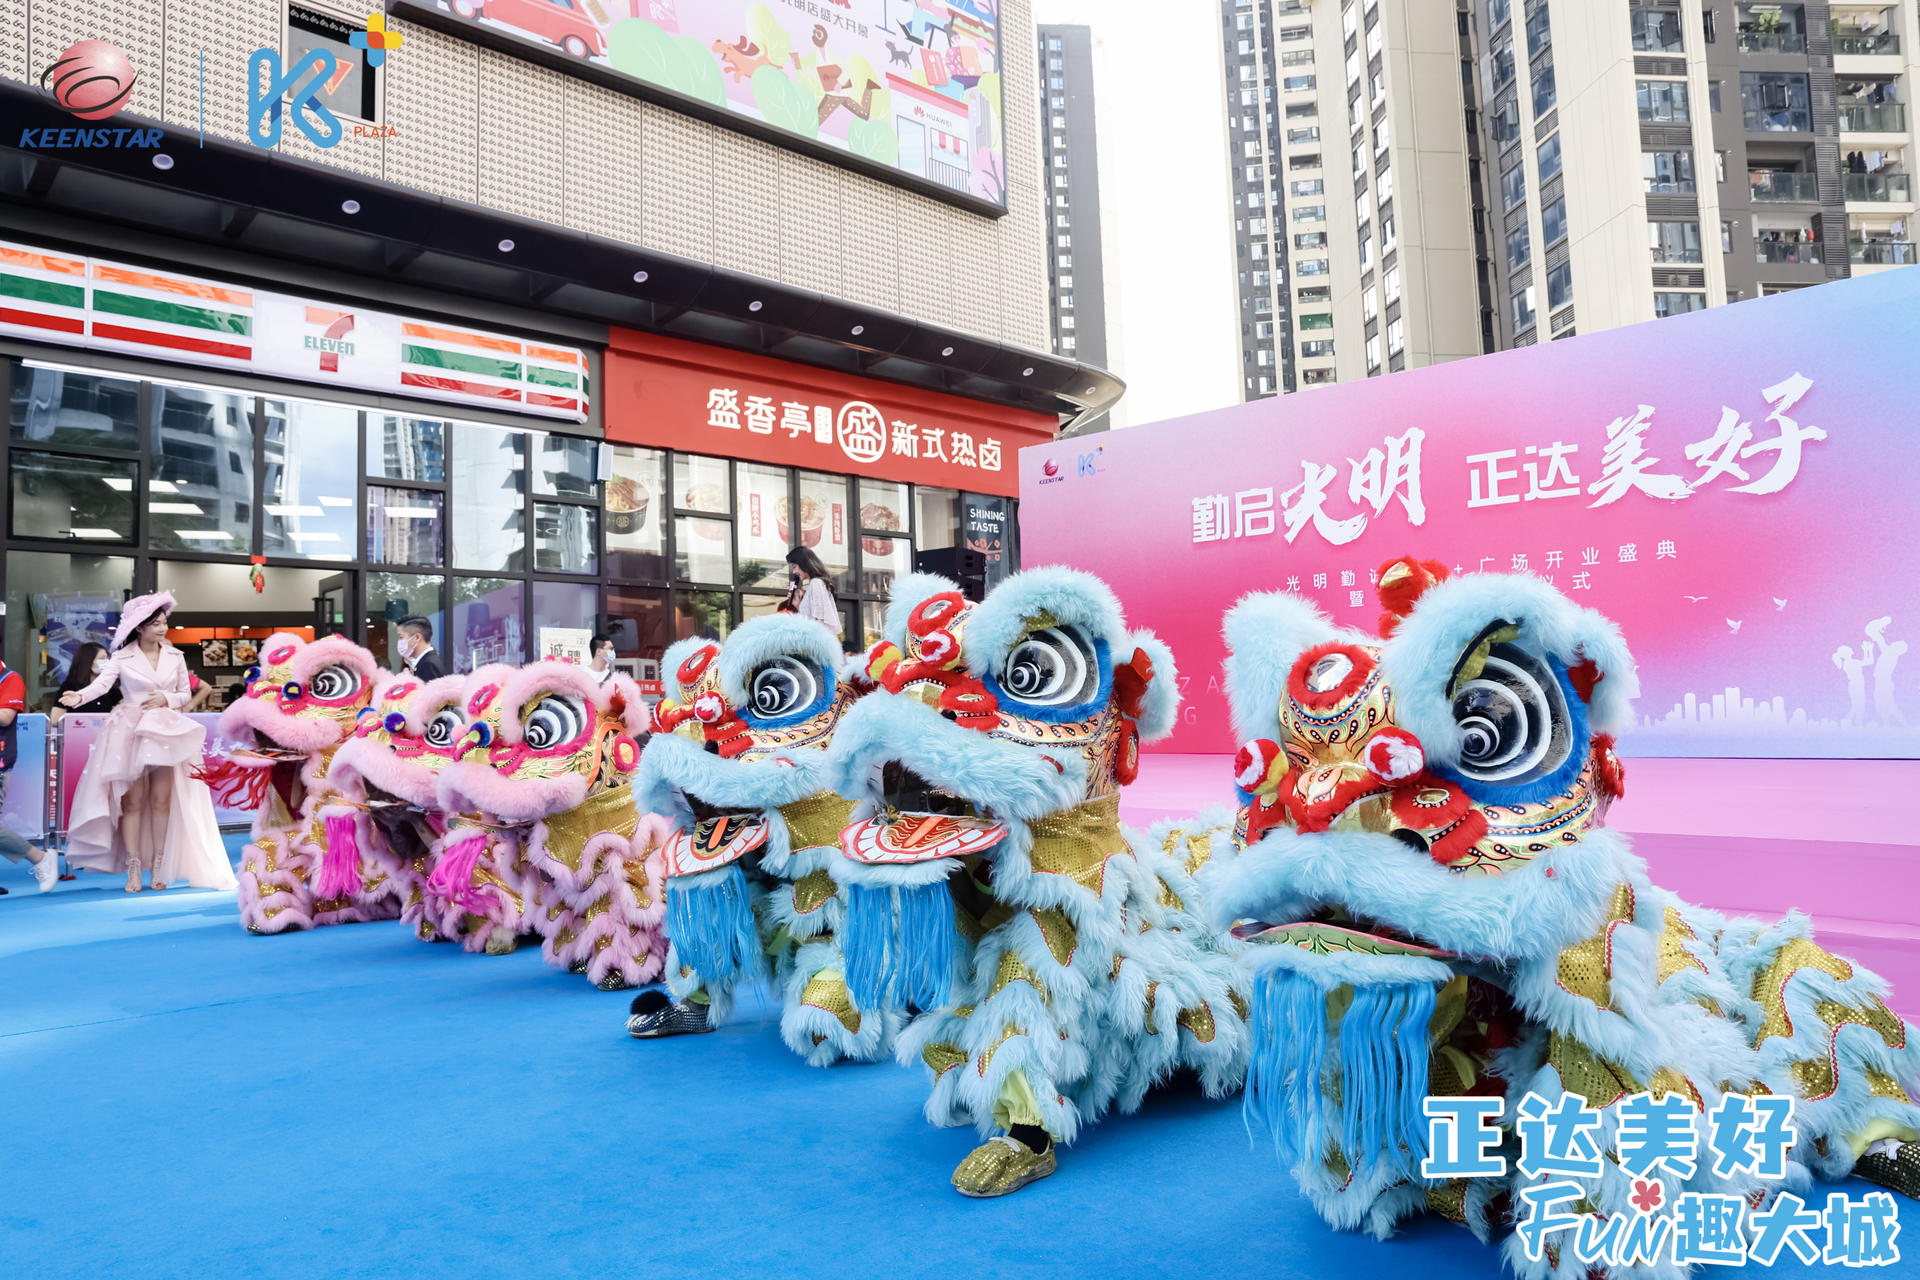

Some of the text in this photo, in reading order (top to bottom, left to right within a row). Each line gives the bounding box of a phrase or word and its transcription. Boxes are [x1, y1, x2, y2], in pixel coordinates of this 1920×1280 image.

[926, 112, 953, 127] HUAWEI
[707, 388, 811, 438] 盛香亭
[841, 406, 884, 459] 盛
[891, 420, 1001, 471] 新式热卤
[1191, 371, 1828, 546] 勤启光明 正达美好
[970, 508, 1005, 522] SHINING
[971, 521, 999, 534] TASTE
